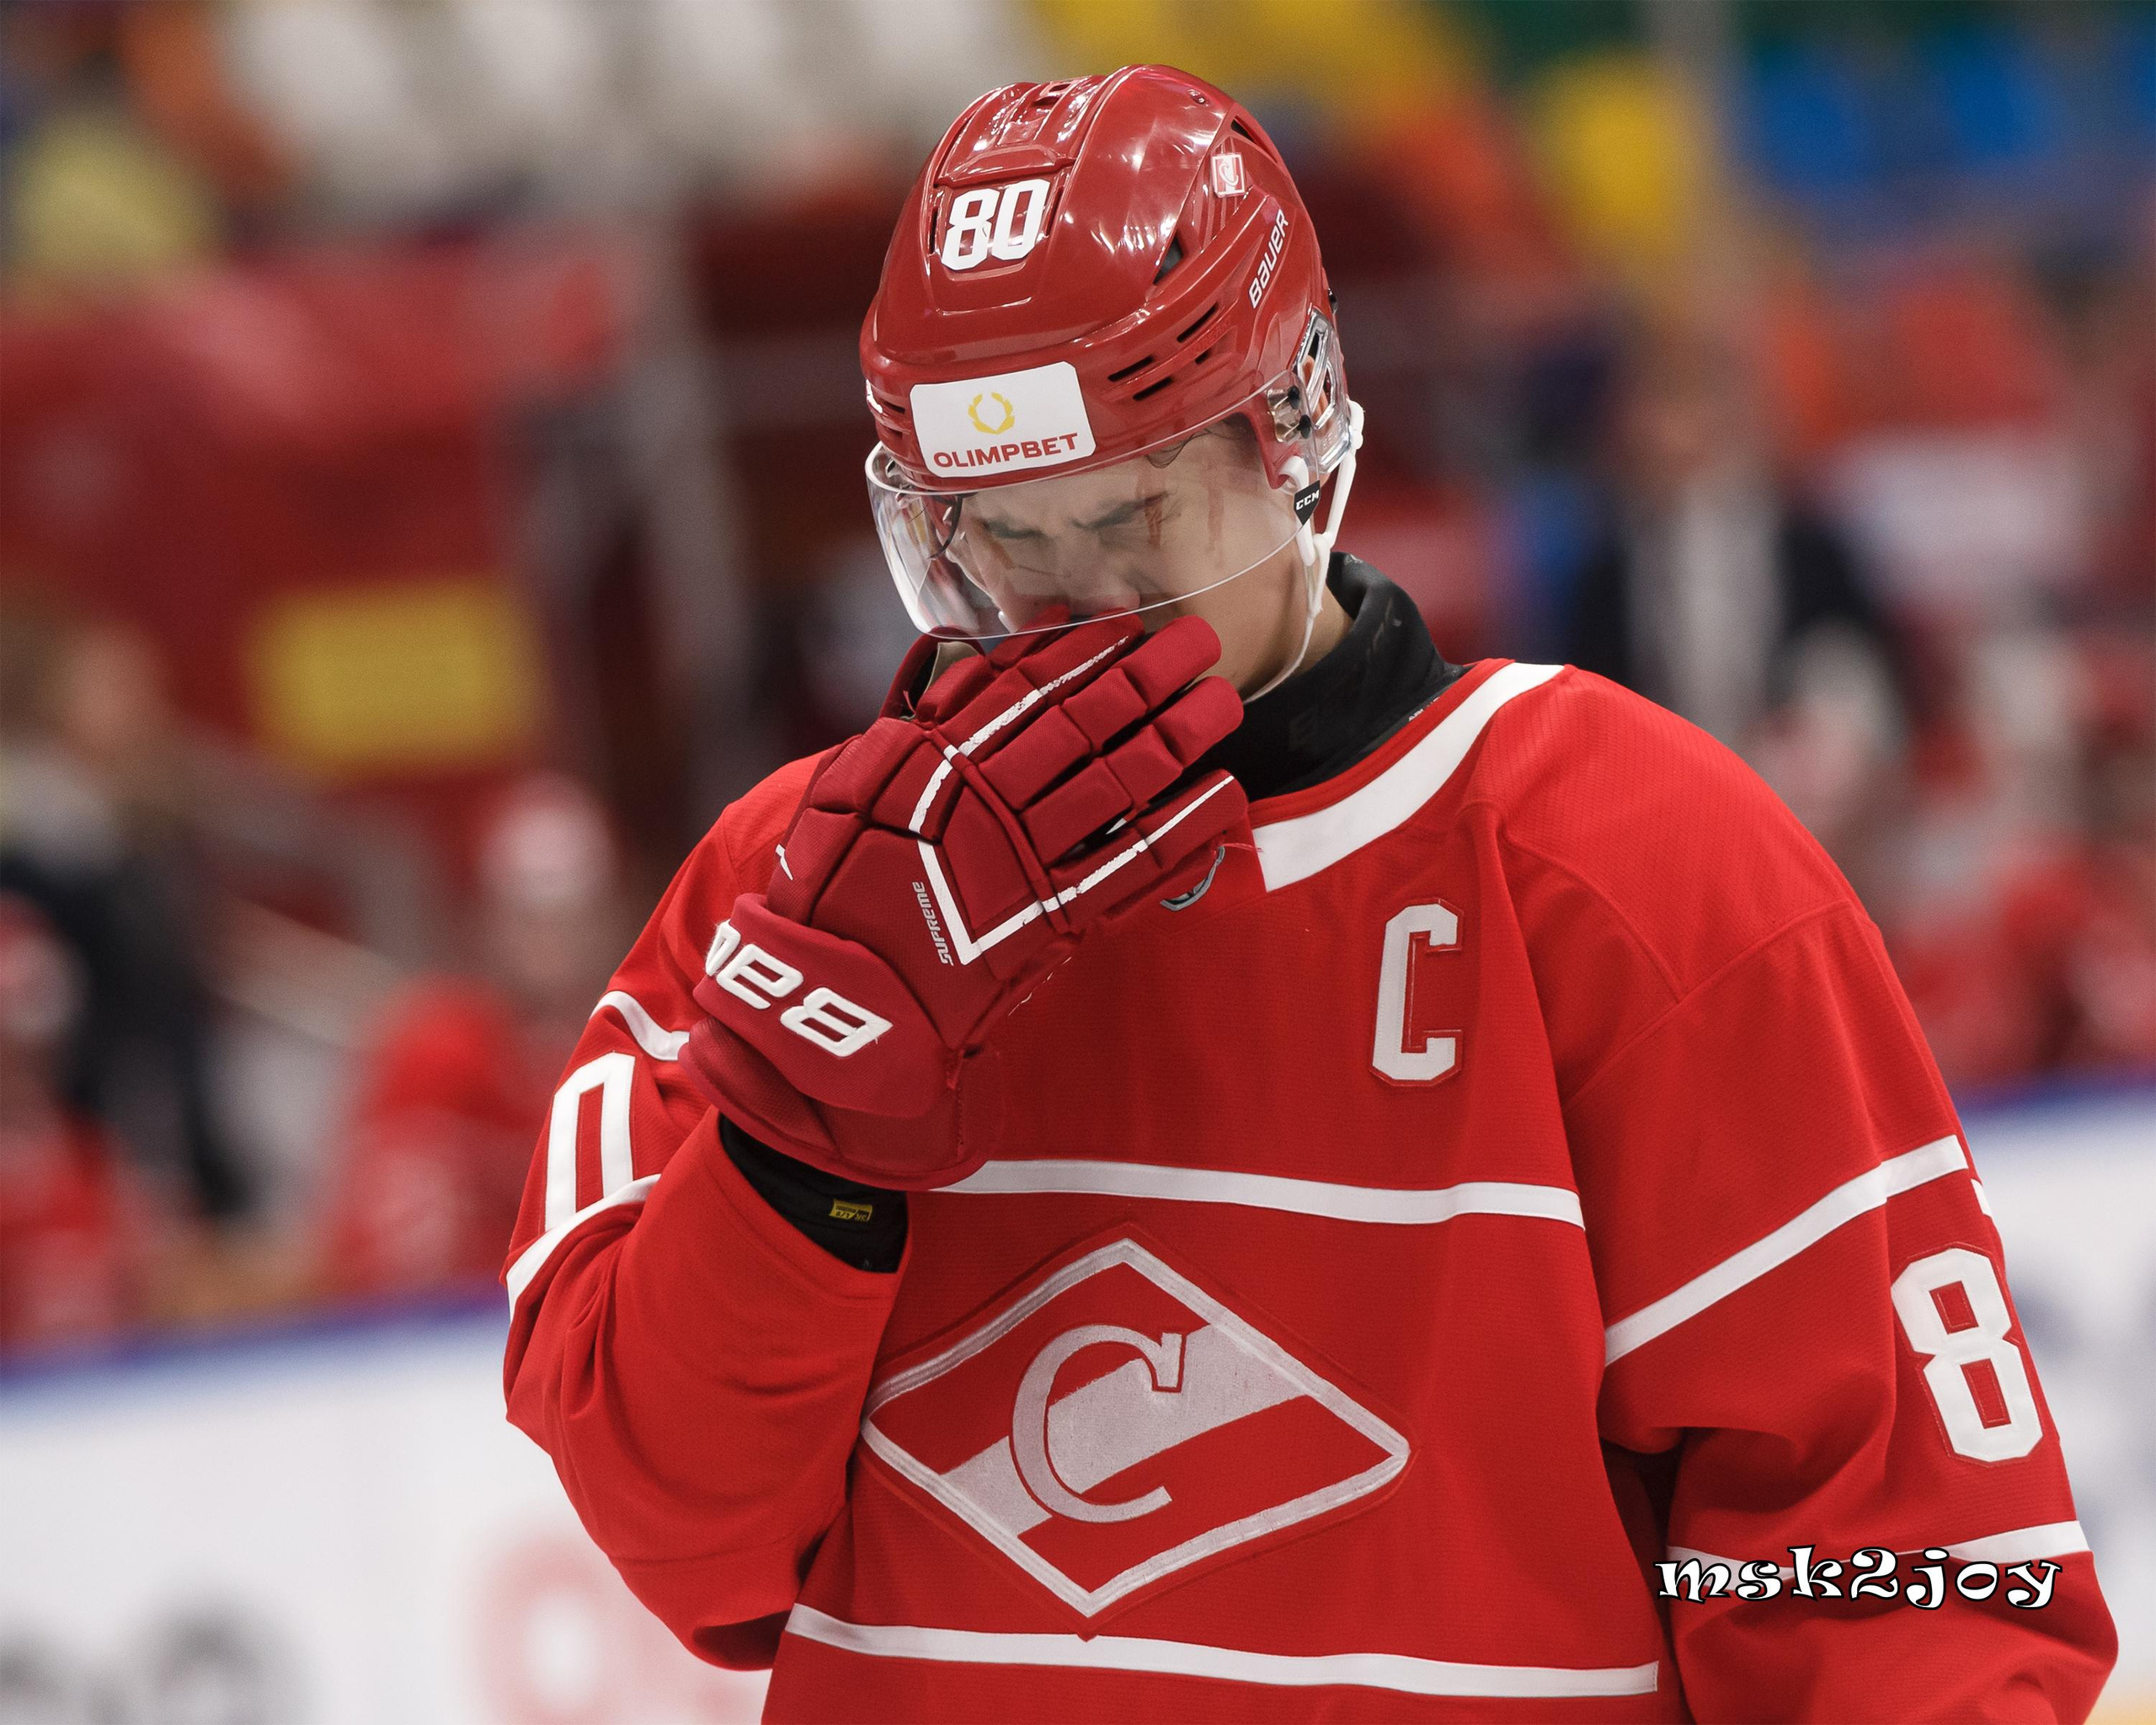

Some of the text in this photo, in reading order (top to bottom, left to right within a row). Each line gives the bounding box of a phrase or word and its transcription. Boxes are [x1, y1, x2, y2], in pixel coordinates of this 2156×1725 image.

[941, 179, 1050, 270] 80
[933, 432, 1078, 468] OLIMPBET
[1295, 489, 1320, 510] CCM
[1372, 904, 1459, 1081] C
[1891, 1247, 2043, 1462] 8
